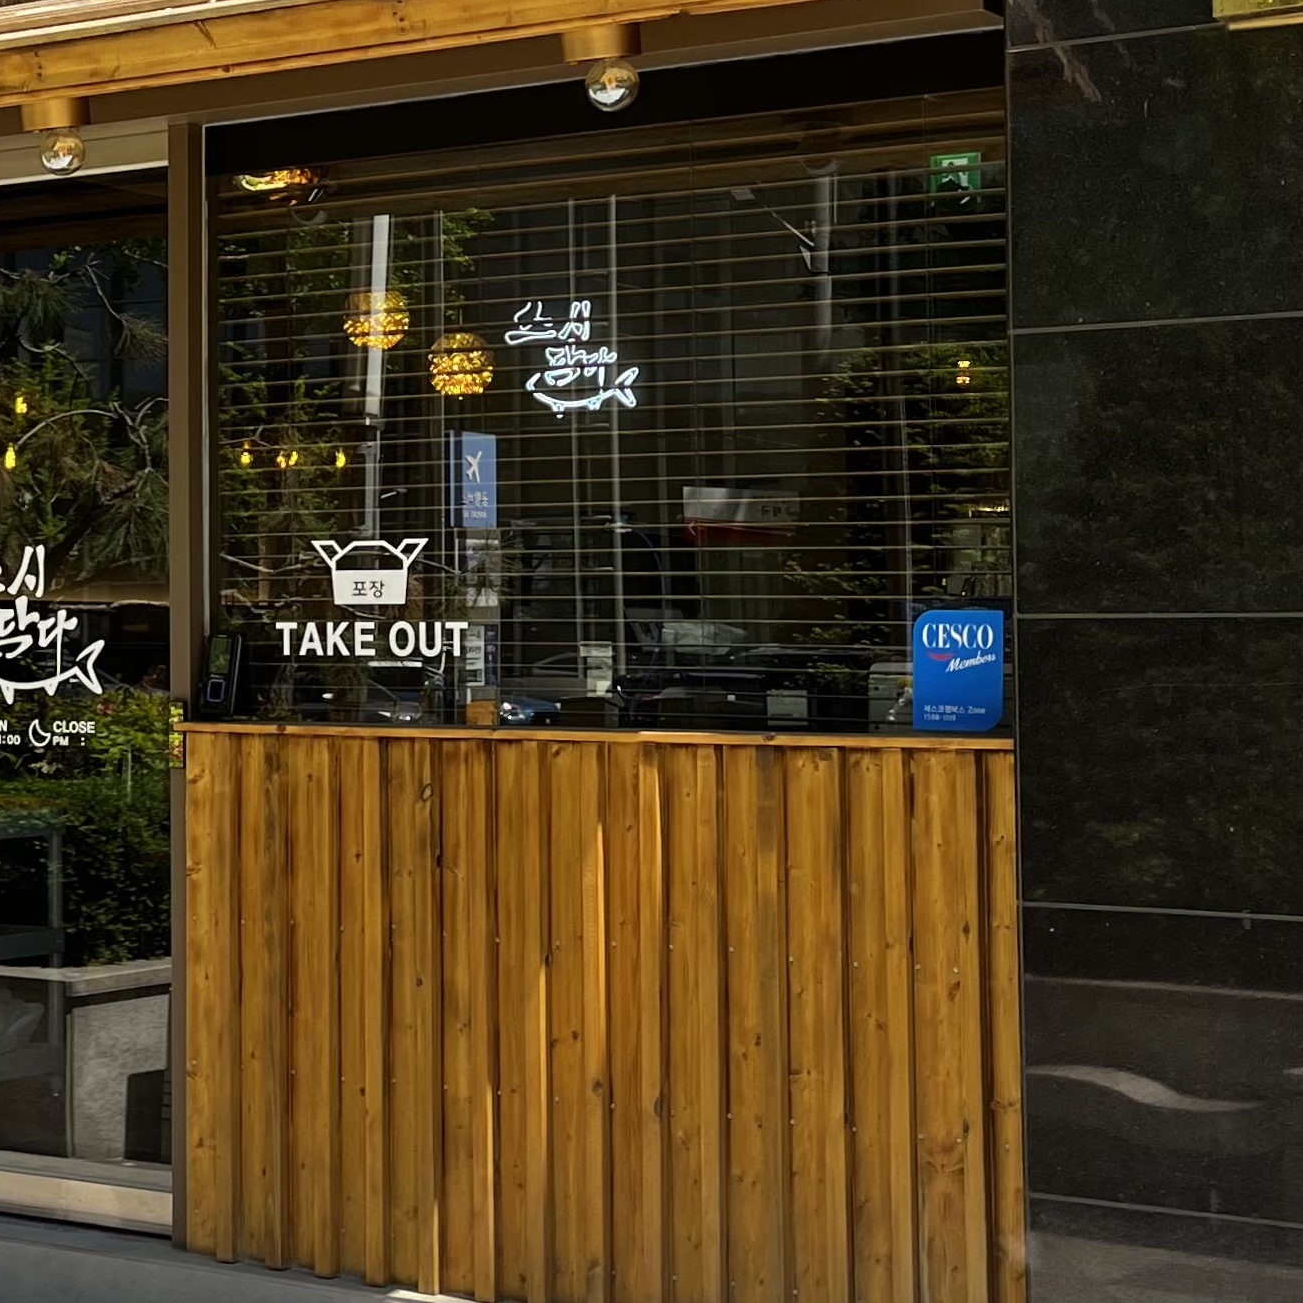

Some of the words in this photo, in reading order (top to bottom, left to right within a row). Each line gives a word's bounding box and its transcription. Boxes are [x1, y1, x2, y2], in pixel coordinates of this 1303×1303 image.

[351, 580, 385, 598] 포장
[276, 621, 376, 657] TAKE
[388, 620, 469, 657] OUT
[922, 622, 994, 649] CESCO
[945, 650, 996, 673] Members
[52, 719, 96, 734] CLOSE
[52, 736, 69, 746] PM
